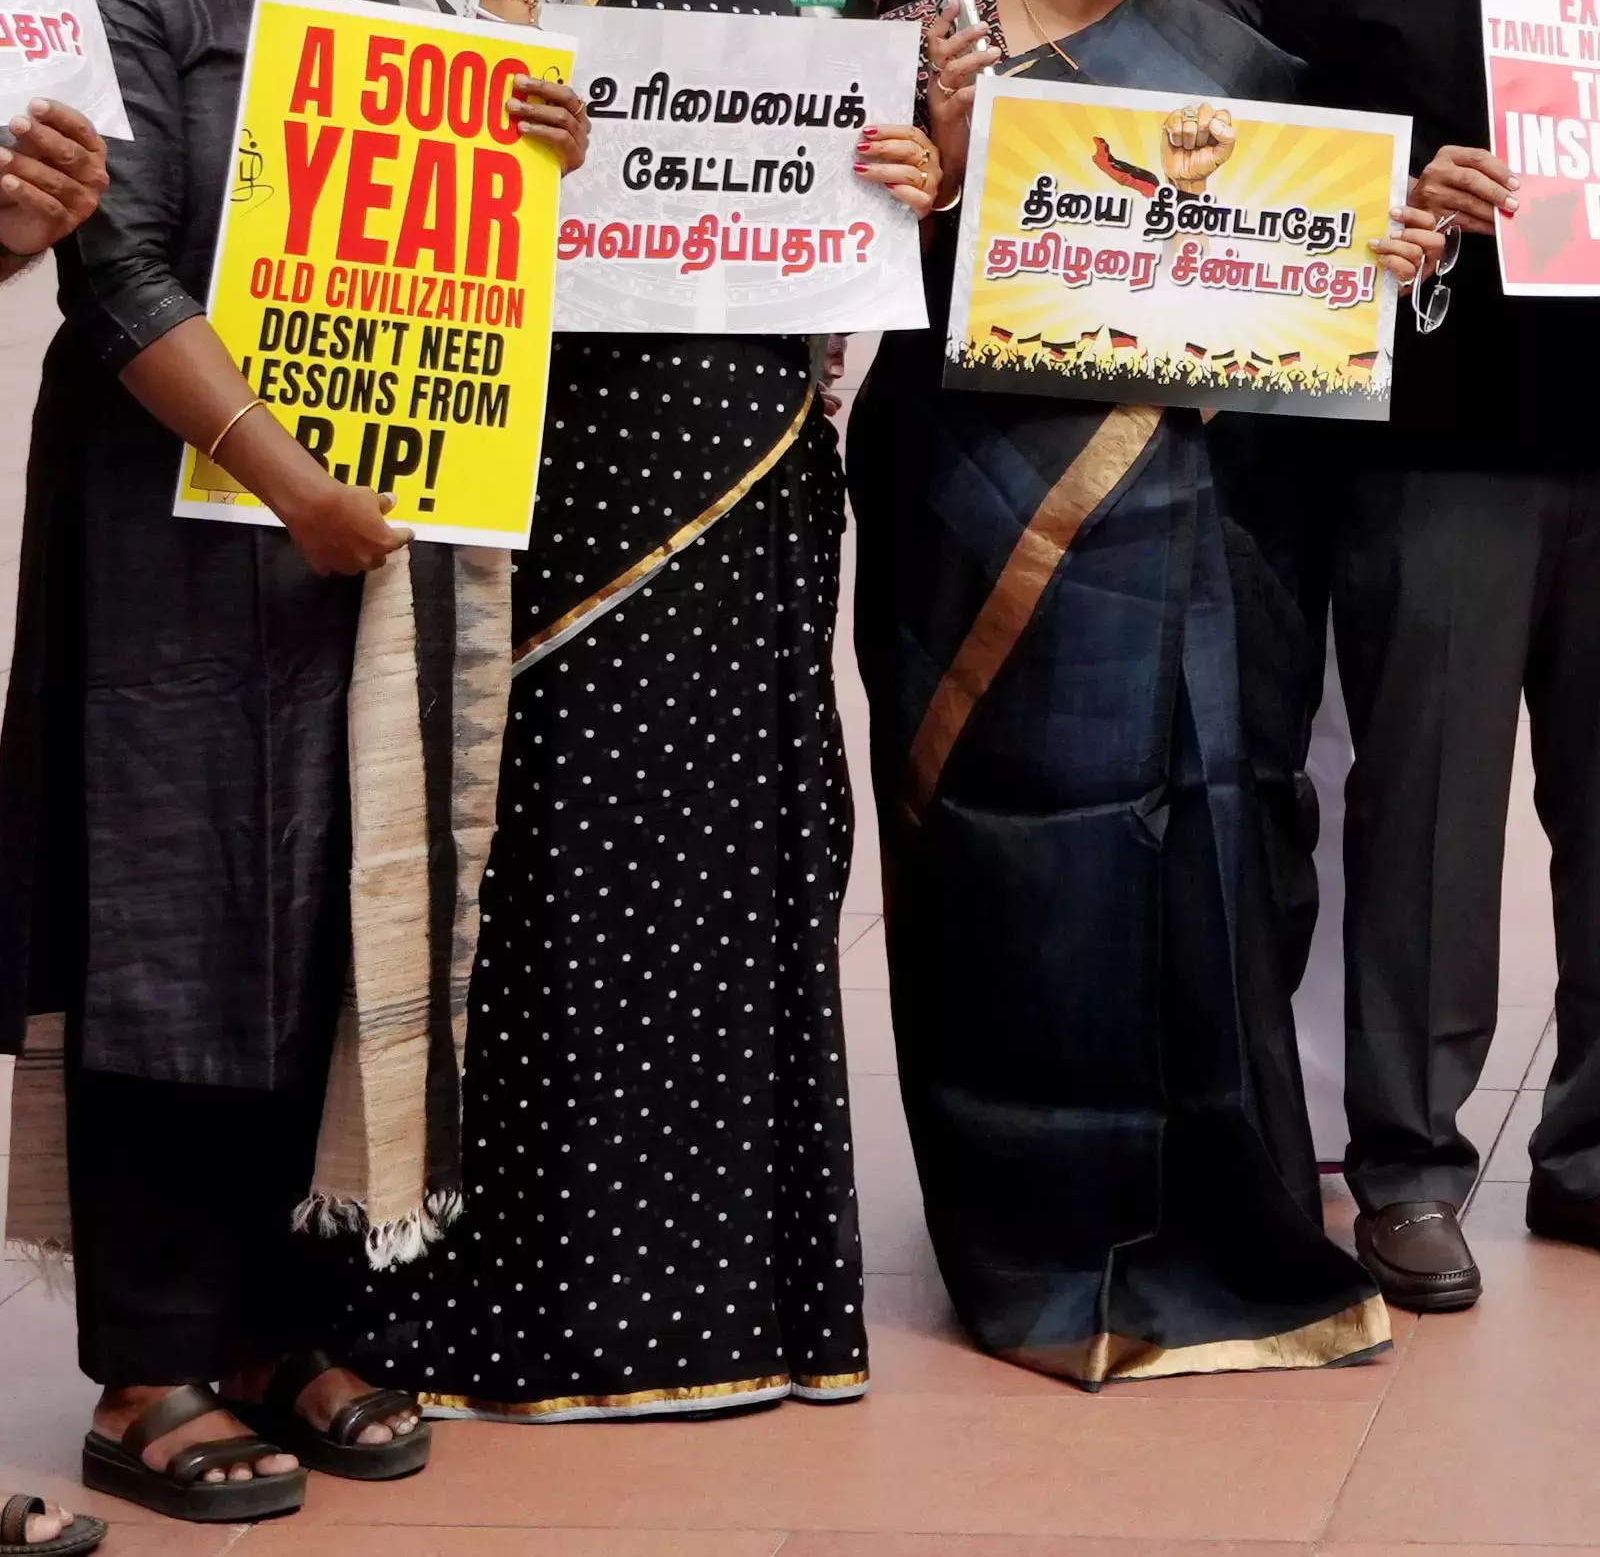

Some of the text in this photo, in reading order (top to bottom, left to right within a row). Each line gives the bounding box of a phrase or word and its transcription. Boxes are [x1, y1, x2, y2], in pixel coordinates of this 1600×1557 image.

[1488, 18, 1569, 57] TAMIL
[289, 26, 532, 145] A 5000
[586, 72, 867, 129] உரிமையைக்
[282, 120, 522, 282] YEAR
[622, 145, 815, 194] கேட்டால்
[557, 211, 875, 277] அவமதிப்பதா?
[1021, 176, 1353, 250] தீயை தீண்டாதே!
[249, 256, 525, 329] OLD CIVILIZATION
[986, 233, 1376, 305] தமிழரை சீண்டாதே!
[418, 324, 505, 377] NEED
[408, 375, 510, 429] FROM
